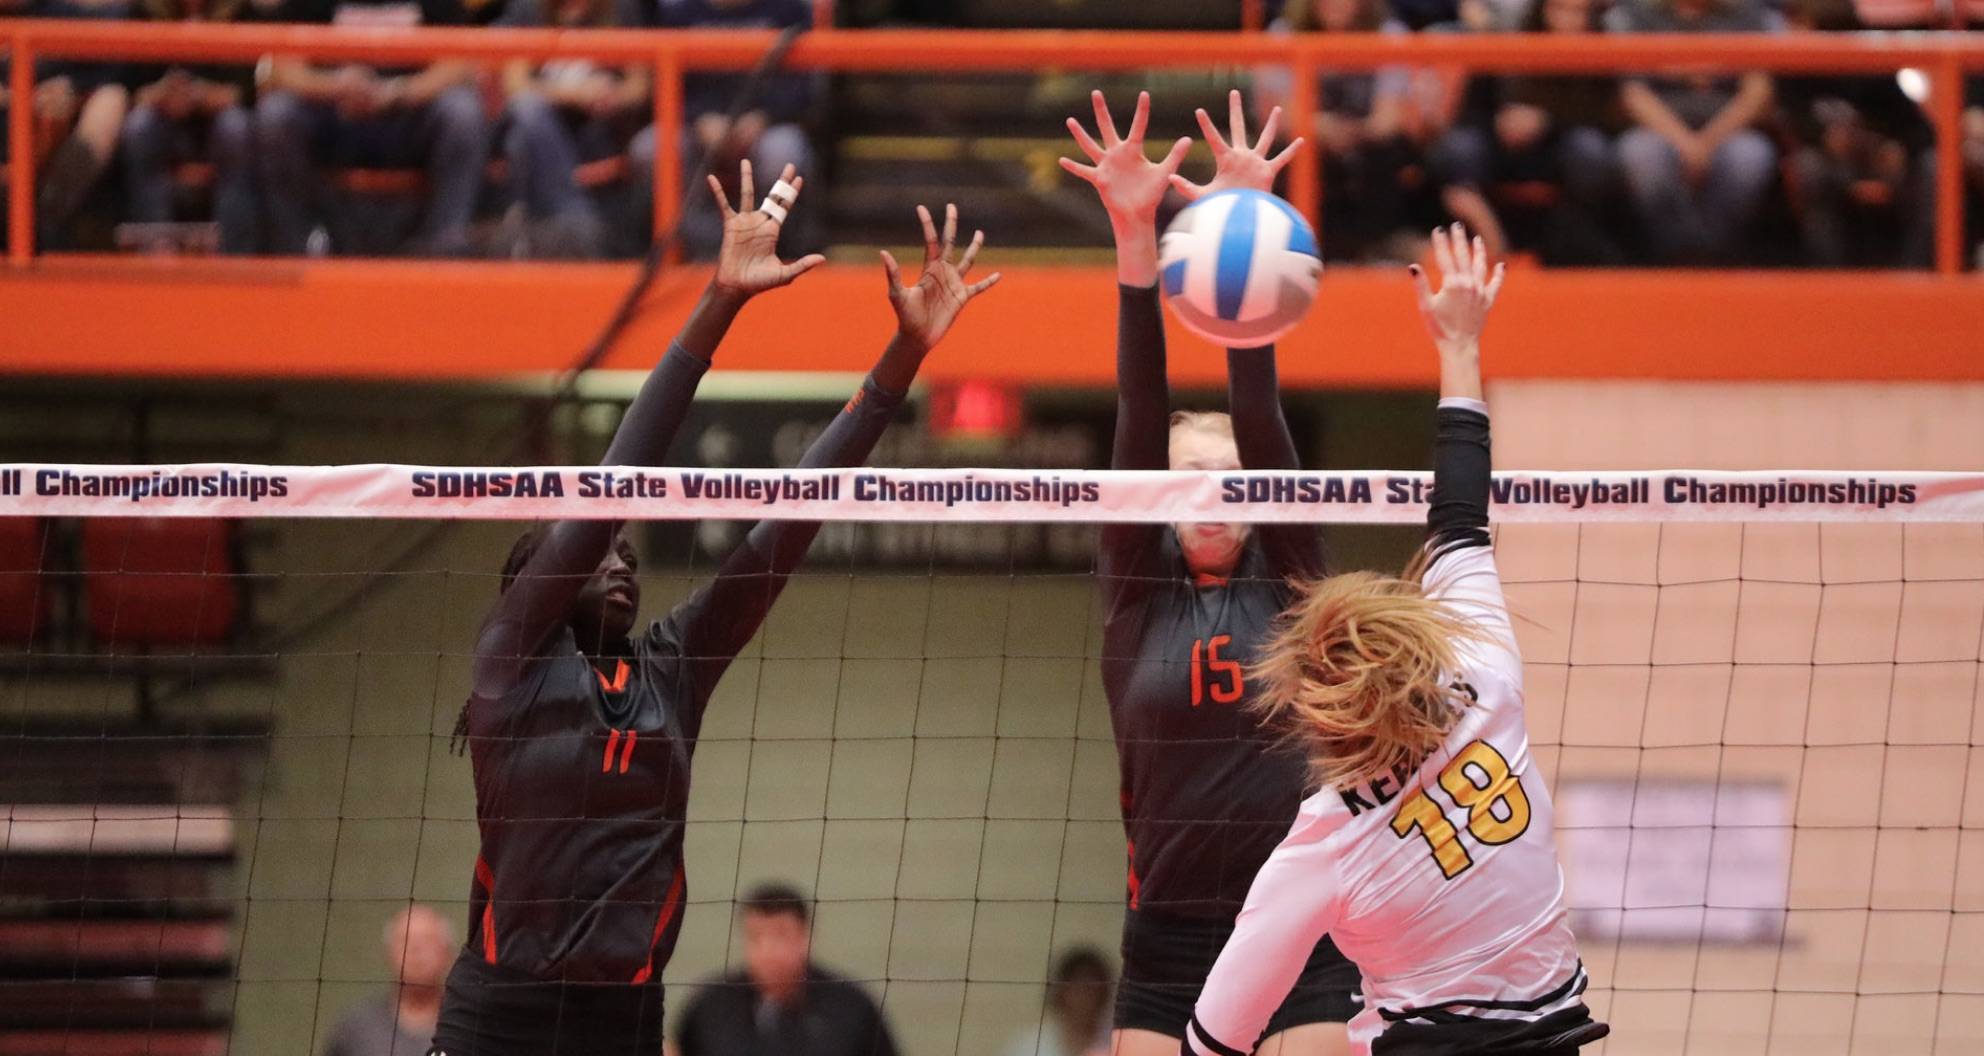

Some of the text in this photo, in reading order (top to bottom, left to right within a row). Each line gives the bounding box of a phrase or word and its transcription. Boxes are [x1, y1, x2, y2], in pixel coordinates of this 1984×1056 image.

[36, 469, 288, 502] Championships
[412, 471, 1101, 507] SDHSAA State Volleyball Championships
[1221, 476, 1917, 509] SDHSAA Sta Volleyball Championships
[1190, 634, 1245, 707] 15
[602, 727, 638, 775] 11
[1388, 738, 1532, 881] 18
